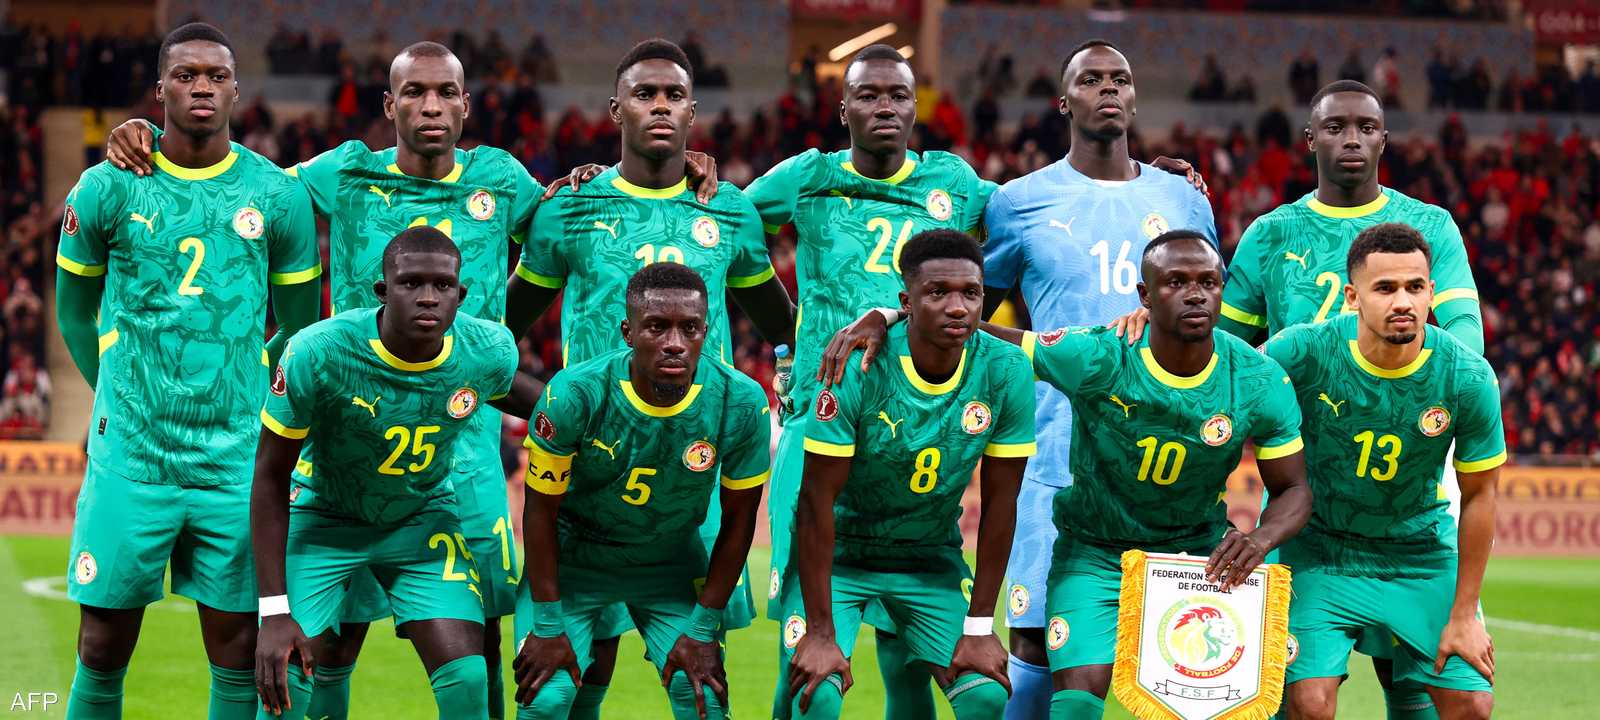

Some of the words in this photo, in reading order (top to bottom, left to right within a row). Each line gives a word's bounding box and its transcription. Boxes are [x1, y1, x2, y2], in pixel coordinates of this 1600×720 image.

[178, 237, 205, 295] 2
[1089, 240, 1137, 295] 16
[1313, 272, 1359, 324] 2
[378, 426, 440, 474] 25
[529, 462, 570, 482] CAF
[910, 448, 941, 493] 8
[1136, 436, 1186, 485] 10
[1354, 431, 1402, 481] 13
[621, 467, 657, 505] 5
[1152, 569, 1203, 580] FEDERATION
[1178, 582, 1189, 590] DE
